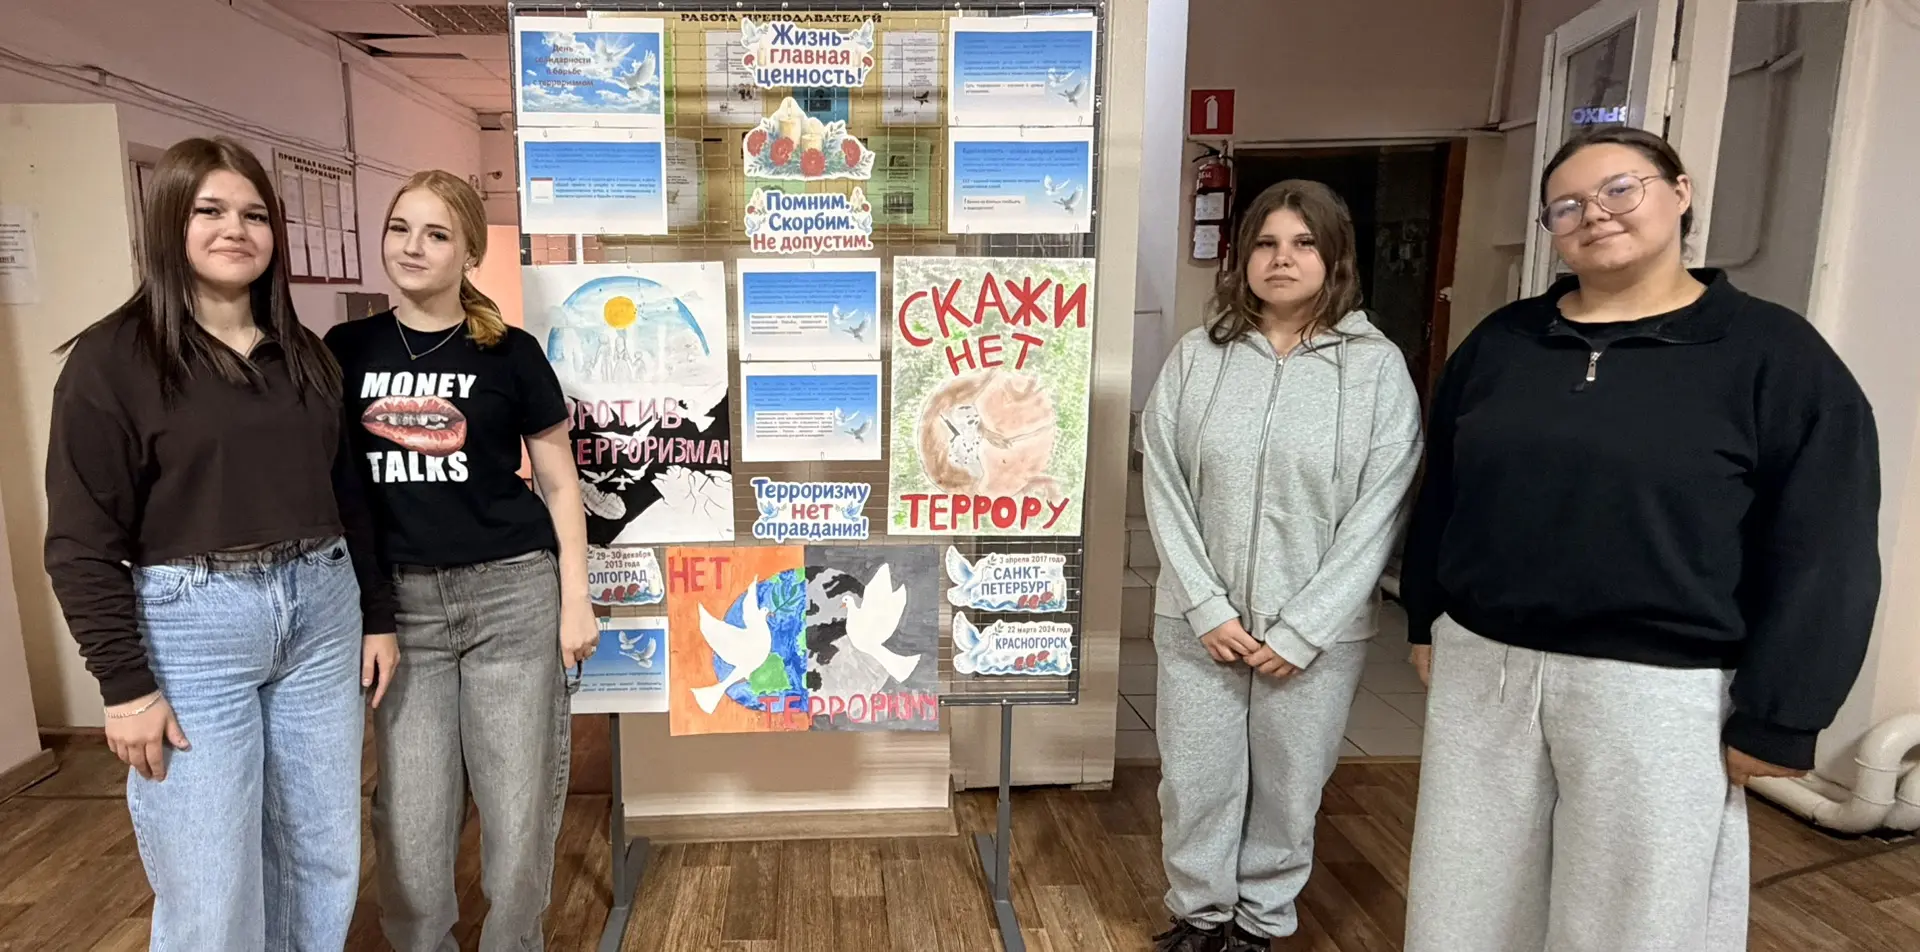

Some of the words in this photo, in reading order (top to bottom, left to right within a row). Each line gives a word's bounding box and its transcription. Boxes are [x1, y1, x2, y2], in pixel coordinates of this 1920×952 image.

[681, 13, 738, 22] РАБОТА
[742, 12, 882, 23] ПРЕПОДАВАТЕЛЕЙ
[771, 23, 850, 47] Жизнь-
[552, 43, 574, 53] День
[770, 48, 850, 65] главная
[553, 67, 583, 76] борьбе
[757, 67, 863, 87] ценность!
[766, 192, 850, 211] Помним.
[769, 212, 855, 235] Скорбим.
[753, 233, 777, 250] Не
[780, 234, 872, 253] допустим.
[899, 271, 1087, 347] СКАЖИ
[945, 332, 1044, 376] НЕТ
[360, 371, 477, 399] MONEY
[577, 436, 729, 466] ЕРРОРИЗМА!
[366, 450, 469, 483] TALKS
[752, 479, 869, 503] Терроризму
[791, 503, 833, 520] нет
[900, 493, 1070, 531] ТЕРРОРУ
[754, 518, 867, 540] оправдания!
[605, 560, 623, 569] 2013
[624, 561, 641, 569] года
[622, 550, 651, 560] декабря
[1005, 556, 1030, 564] апреля
[1031, 555, 1048, 563] 2017
[1048, 555, 1065, 564] года
[588, 569, 648, 585] ОЛГОГРАД
[668, 556, 730, 593] НЕТ
[993, 566, 1046, 580] САНКТ-
[981, 580, 1051, 596] ПЕТЕРБУРГ
[1007, 625, 1015, 633] 22
[1017, 626, 1037, 635] марта
[1038, 625, 1055, 633] 2024
[1056, 626, 1071, 634] года
[995, 637, 1067, 650] КРАСНОГОРСК
